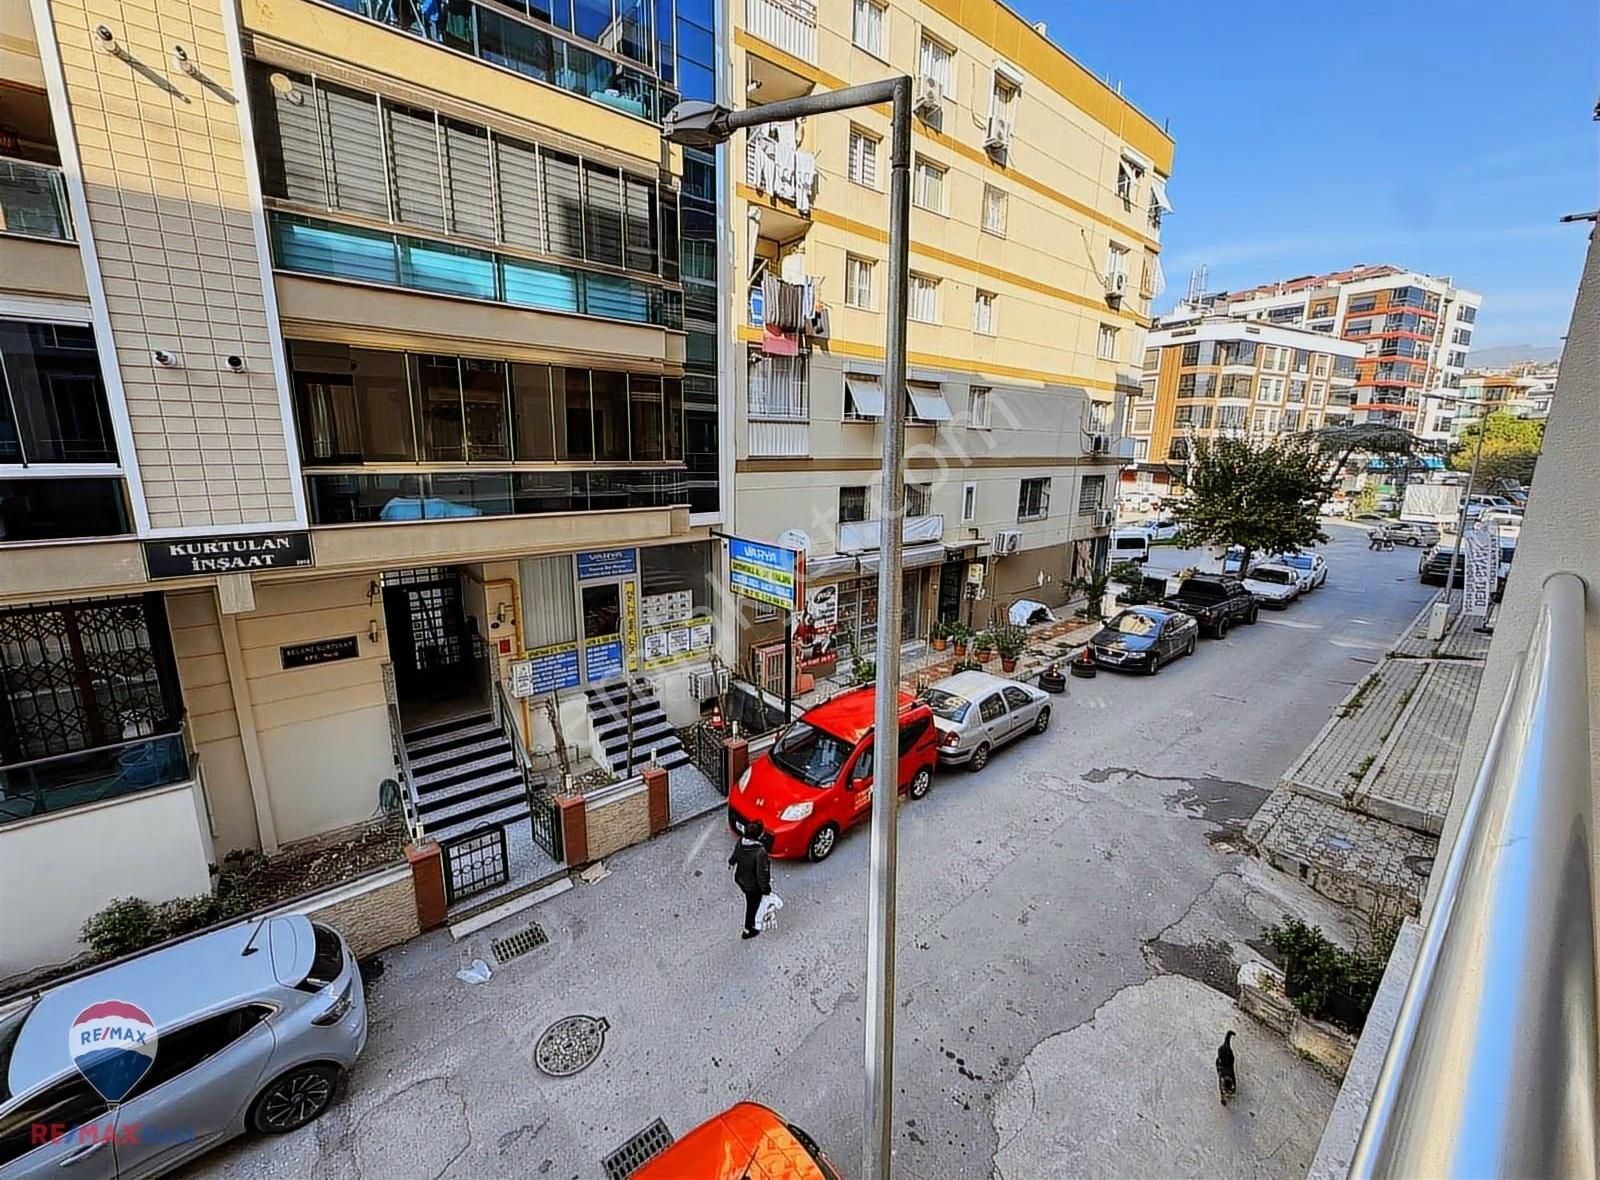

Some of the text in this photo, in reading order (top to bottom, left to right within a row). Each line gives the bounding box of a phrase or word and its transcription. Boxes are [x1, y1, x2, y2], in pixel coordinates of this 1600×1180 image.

[169, 537, 291, 556] KURTULAN
[743, 545, 777, 562] VARYA
[191, 554, 275, 571] İNŞAAT
